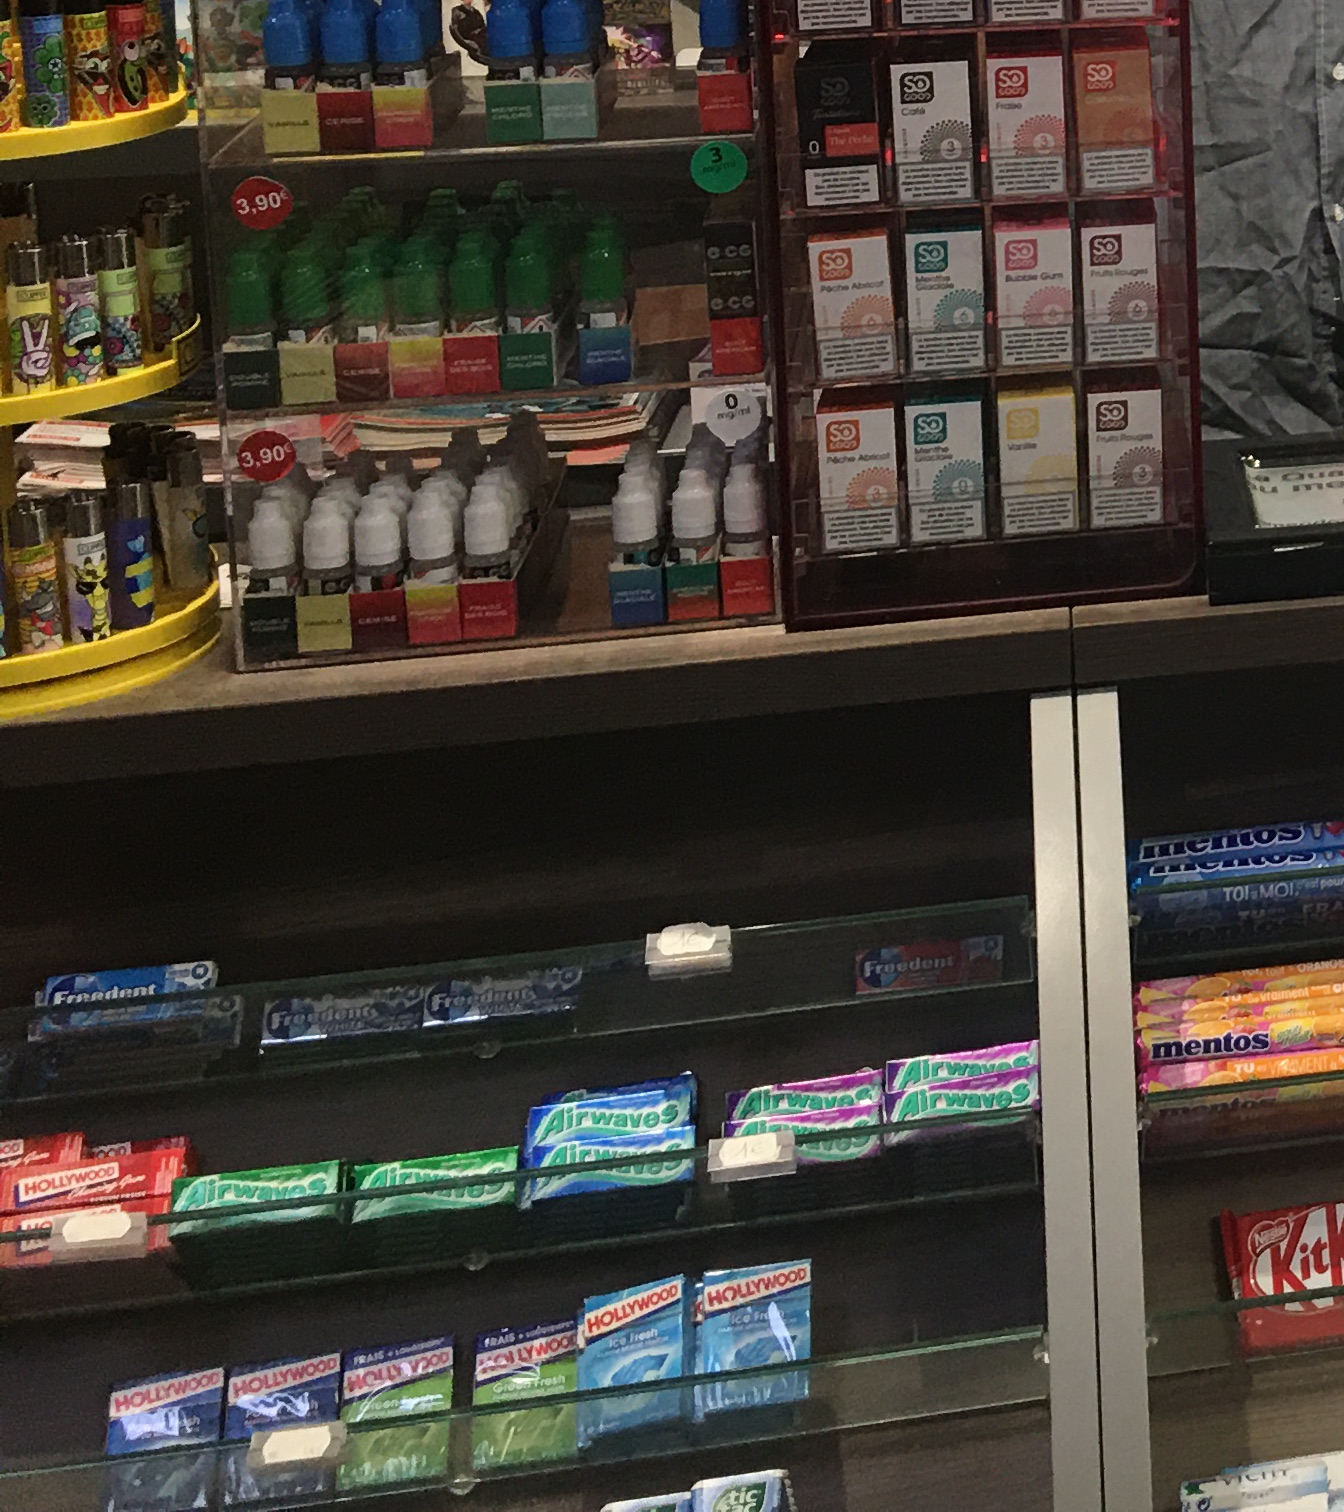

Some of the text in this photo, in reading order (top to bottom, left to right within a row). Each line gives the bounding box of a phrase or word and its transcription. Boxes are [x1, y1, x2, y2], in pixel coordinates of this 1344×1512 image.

[862, 954, 956, 976] Freedent
[1151, 1031, 1270, 1060] mentos
[540, 1101, 680, 1140] Airwaves
[901, 1082, 1031, 1122] Airwaves
[23, 1166, 116, 1197] HOLLYWOOD
[706, 1266, 808, 1308] HOLLYWOOD
[586, 1284, 679, 1334] HOLLYWOOD
[113, 1371, 220, 1413] HOLLYWOOD
[231, 1356, 338, 1398] HOLLYWOOD
